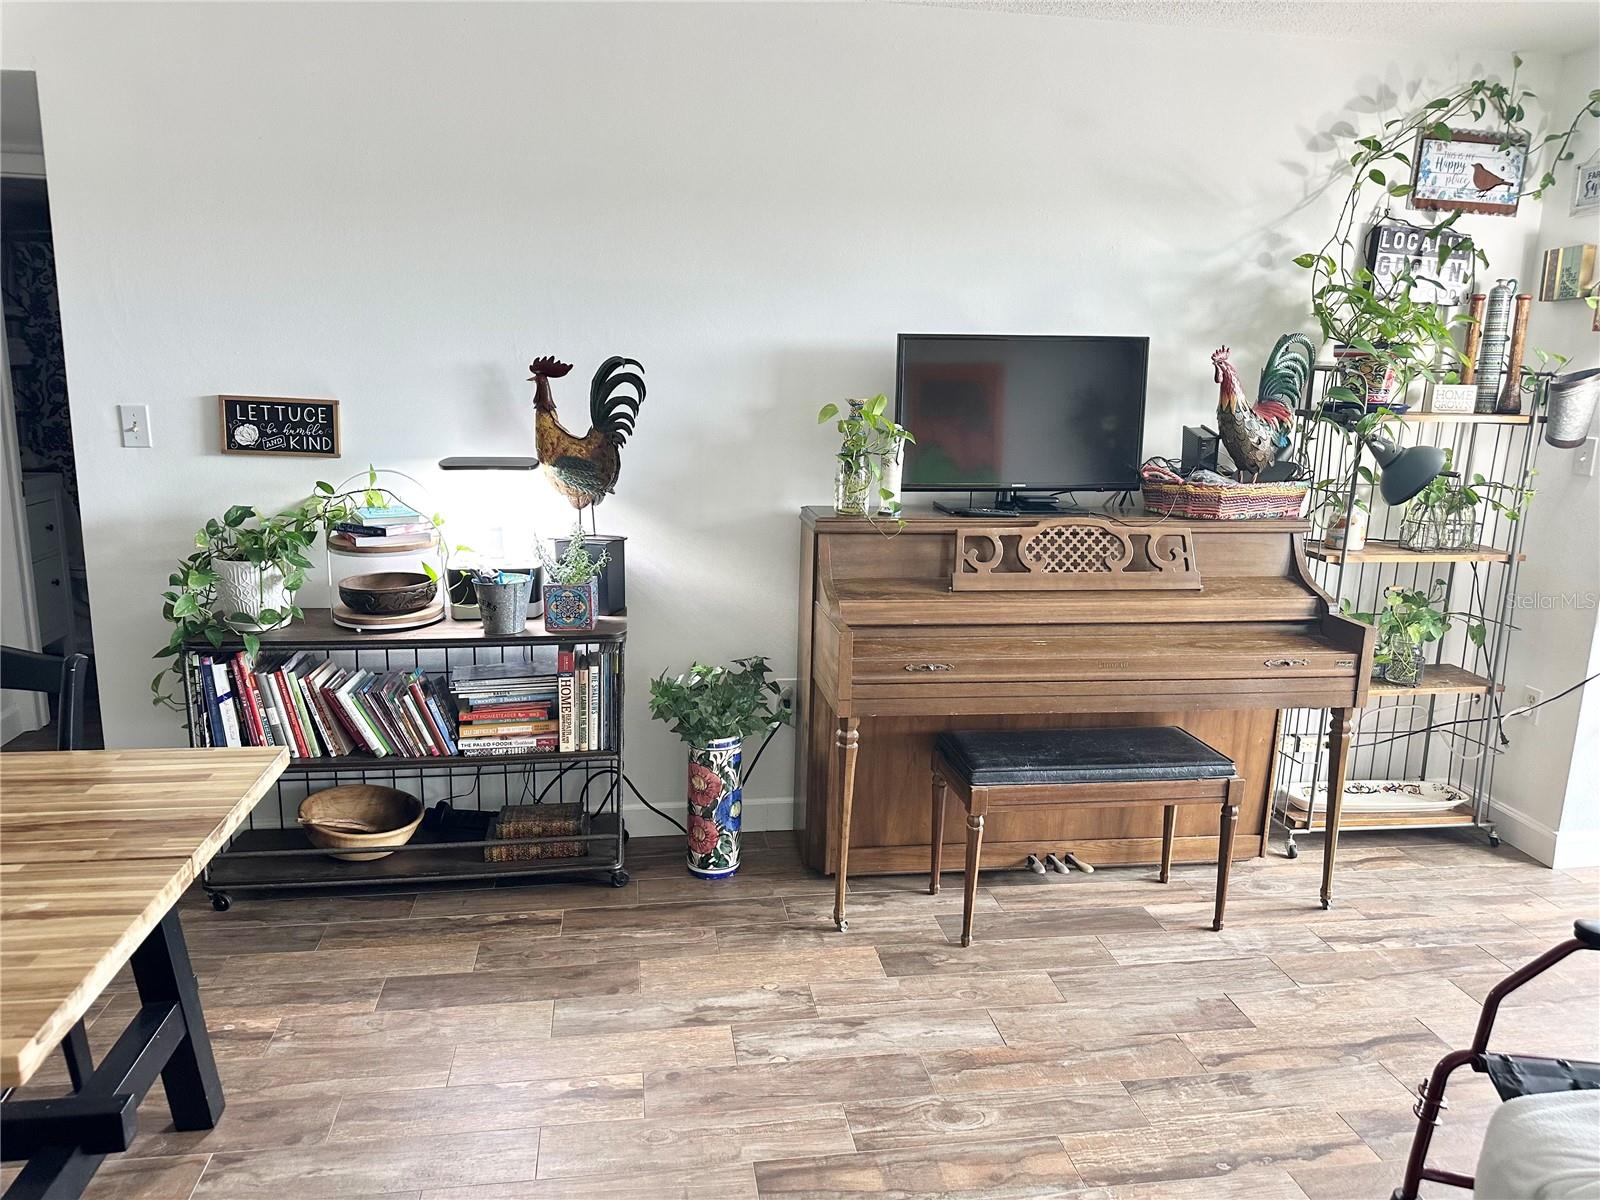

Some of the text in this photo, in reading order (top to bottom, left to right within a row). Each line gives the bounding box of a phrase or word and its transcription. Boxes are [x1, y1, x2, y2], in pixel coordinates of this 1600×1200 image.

[1435, 156, 1466, 174] Happy
[1445, 172, 1469, 187] place
[1381, 230, 1467, 255] LOCAL
[1436, 389, 1474, 400] HOME
[1434, 399, 1473, 409] GROWN
[236, 404, 327, 423] LETTUCE
[282, 424, 325, 436] humble
[265, 435, 332, 451] AND KIND
[560, 678, 571, 714] HOME
